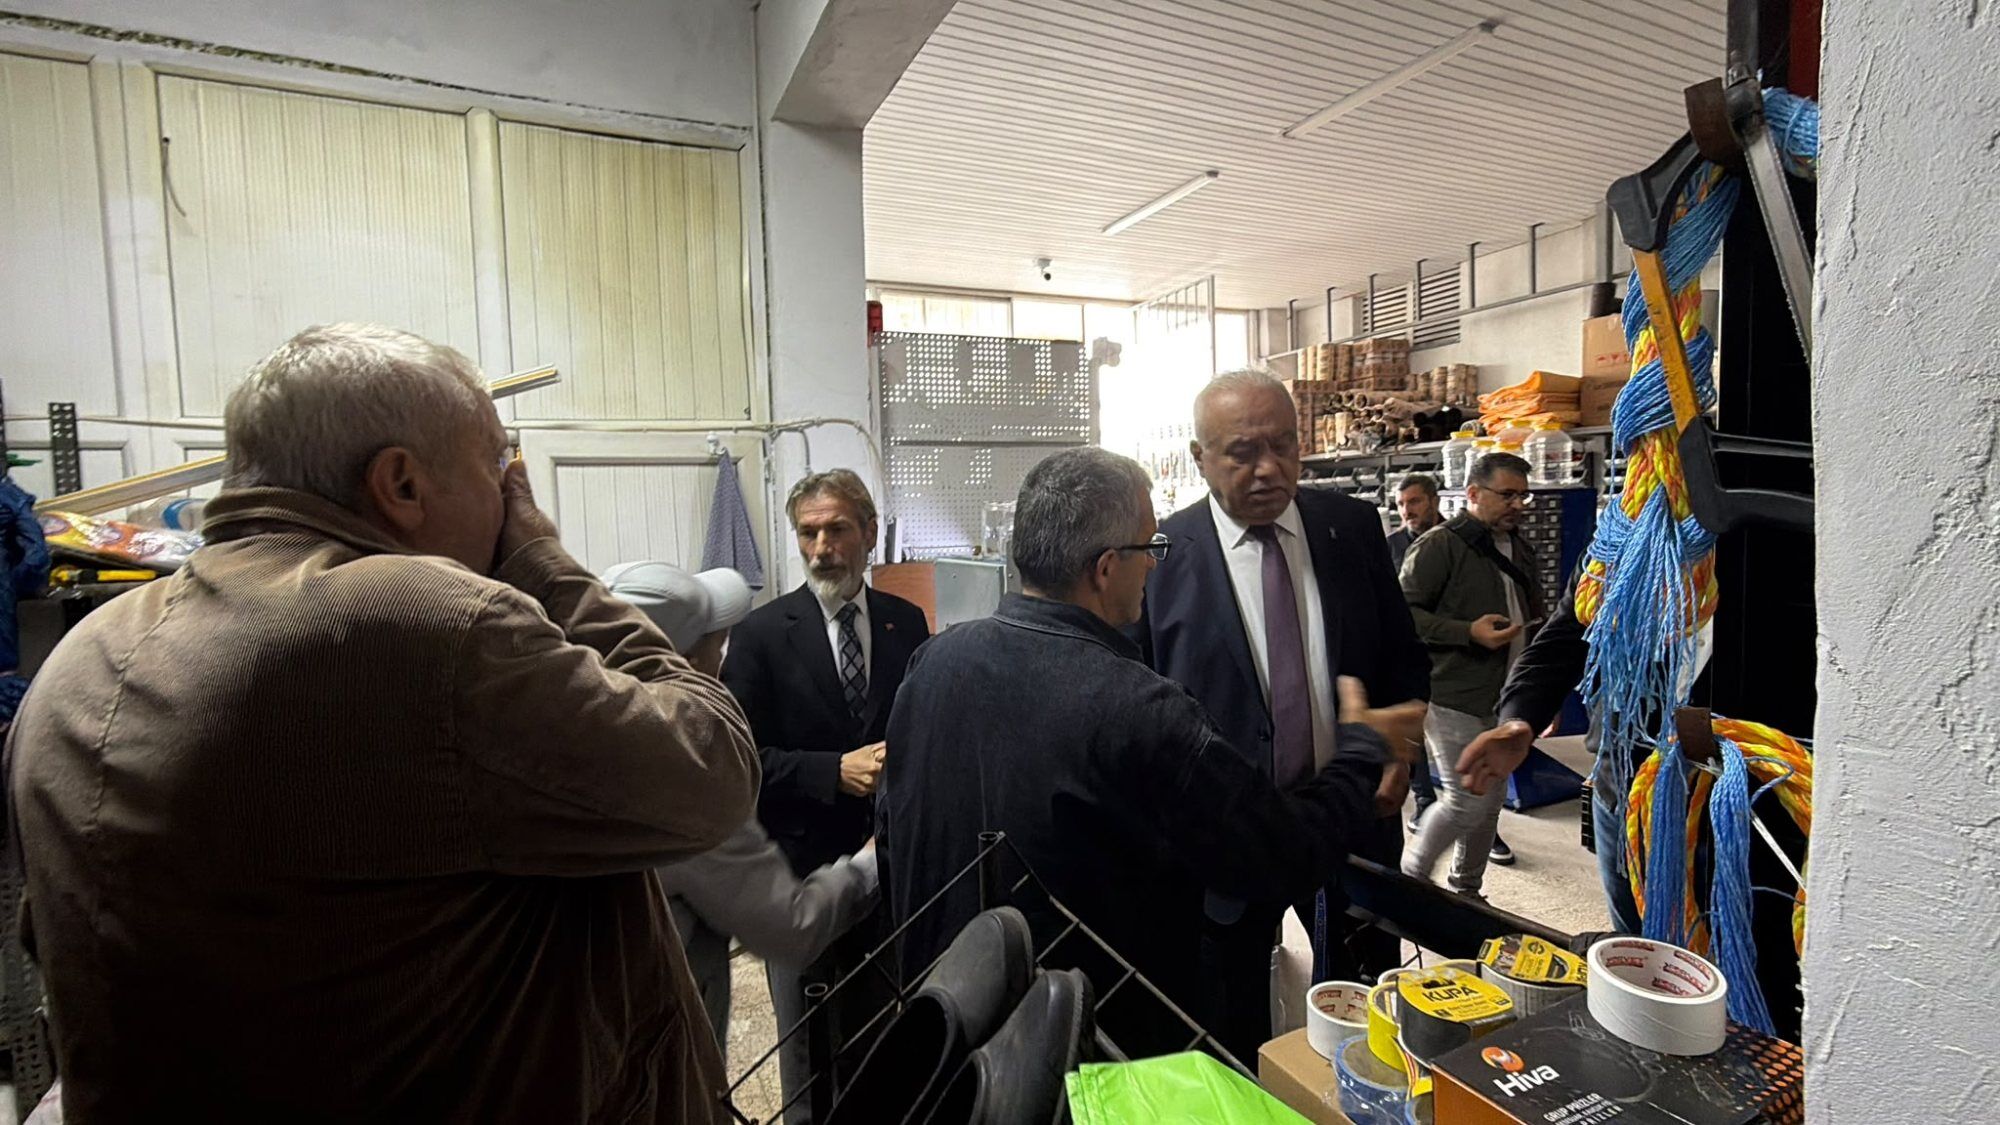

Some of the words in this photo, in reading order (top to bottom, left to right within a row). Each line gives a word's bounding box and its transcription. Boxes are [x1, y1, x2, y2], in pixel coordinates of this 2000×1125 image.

[1422, 985, 1479, 1002] KUPA
[1492, 1064, 1560, 1098] Hiva
[1543, 1107, 1569, 1122] GRUP
